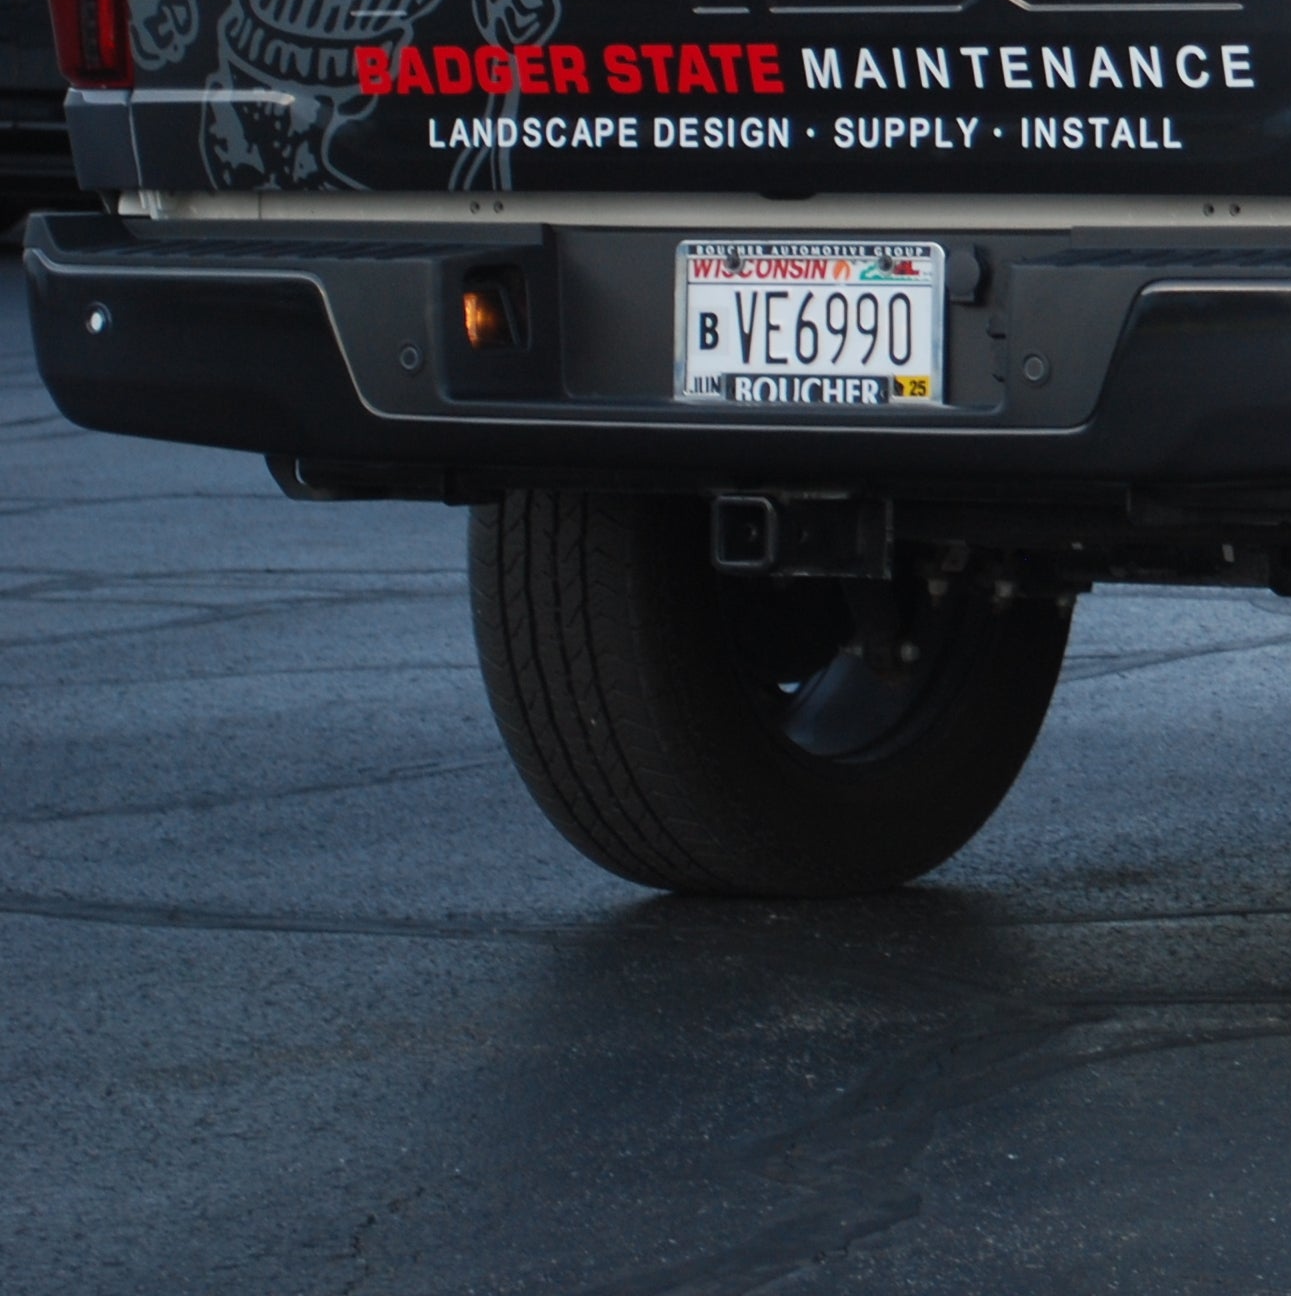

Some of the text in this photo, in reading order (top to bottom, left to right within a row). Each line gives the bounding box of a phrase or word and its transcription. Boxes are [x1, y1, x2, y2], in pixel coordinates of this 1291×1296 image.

[354, 42, 1256, 95] BADGER STATE MAINTENANCE
[428, 116, 1183, 149] LANDSCAPE DESIGN SUPPLY INSTALL
[771, 245, 865, 257] AUTOMOTIVE
[874, 246, 924, 257] GROUP
[699, 290, 912, 366] B VE6990
[909, 380, 927, 397] 25
